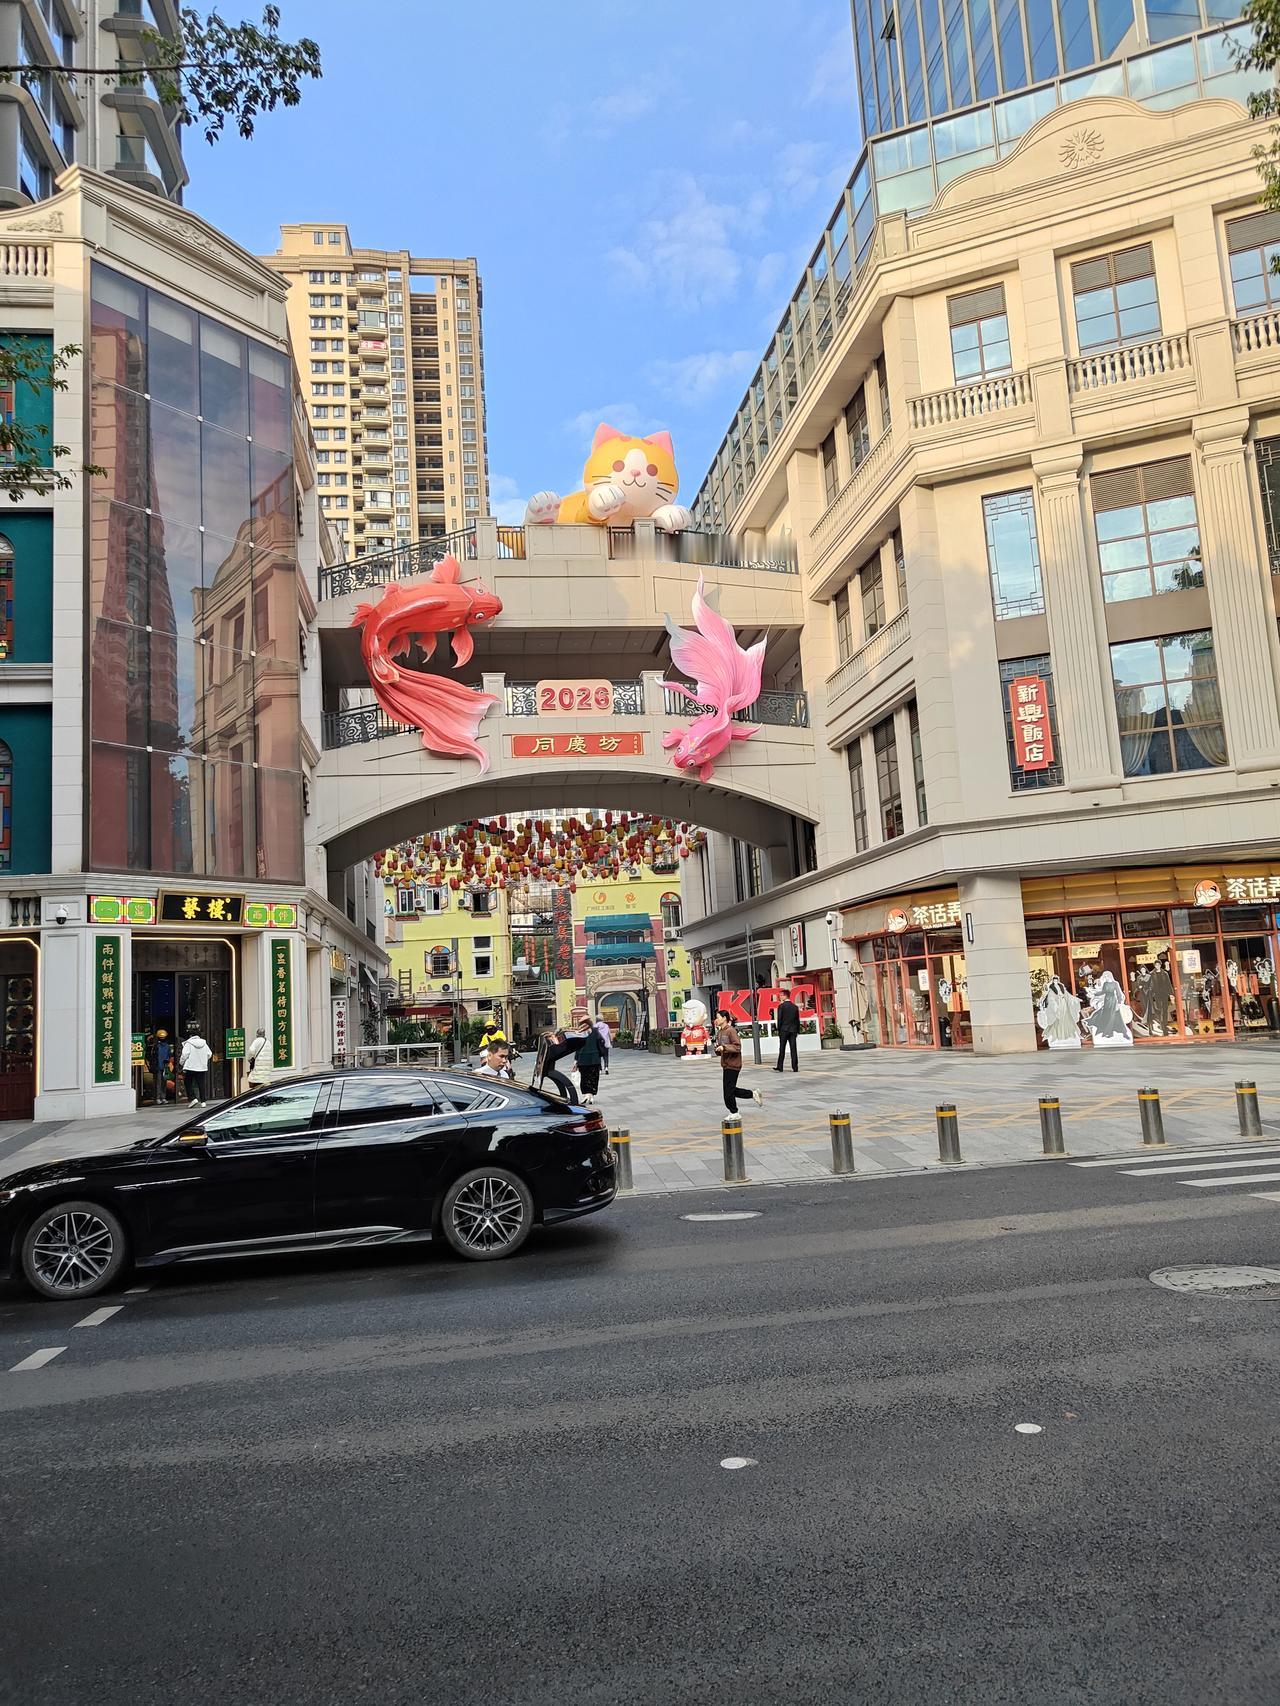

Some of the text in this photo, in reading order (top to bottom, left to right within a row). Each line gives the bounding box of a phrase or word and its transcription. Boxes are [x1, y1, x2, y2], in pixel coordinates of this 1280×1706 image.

[541, 687, 610, 711] 2026
[1017, 684, 1045, 762] 新興飯店
[531, 735, 622, 755] 同慶坊
